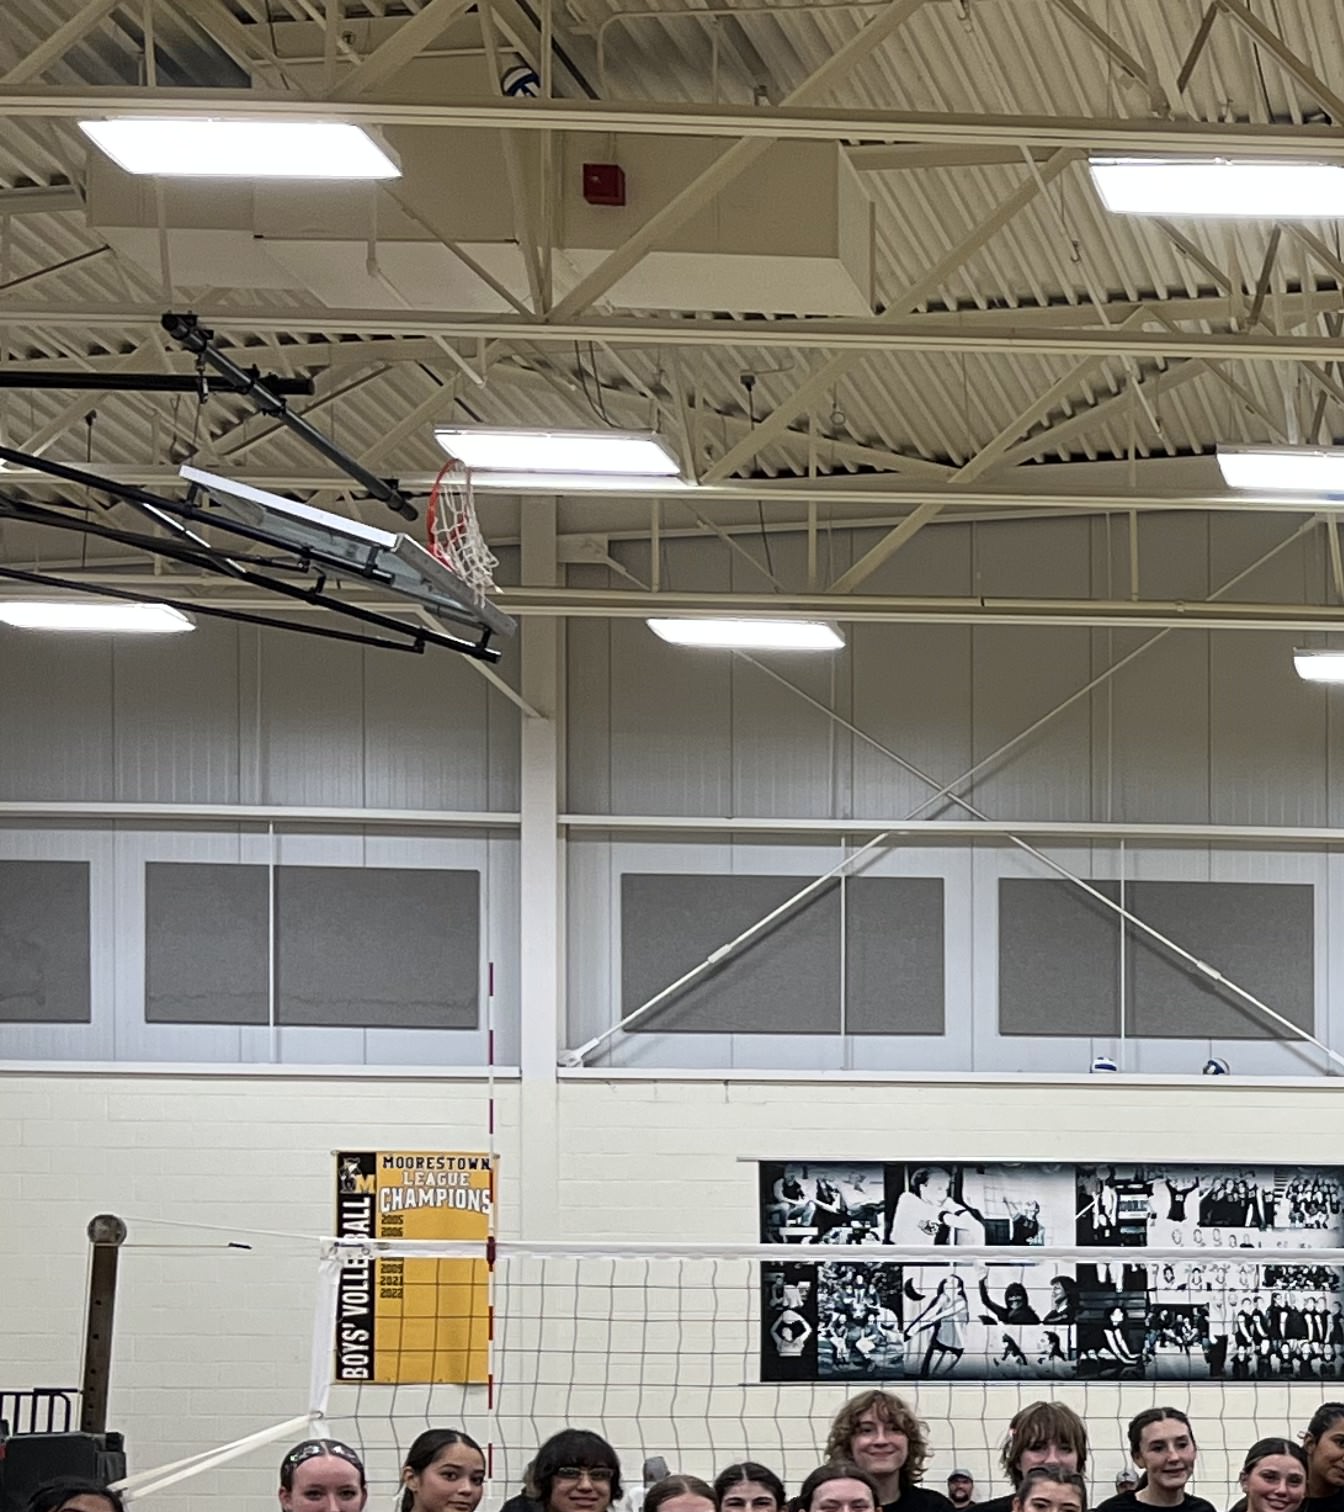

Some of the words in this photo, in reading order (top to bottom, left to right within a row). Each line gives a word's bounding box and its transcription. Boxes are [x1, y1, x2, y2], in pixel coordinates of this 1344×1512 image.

[383, 1156, 491, 1170] MOORESTOWN
[403, 1172, 470, 1187] LEAGUE
[380, 1187, 491, 1214] CHAMPIONS
[341, 1323, 370, 1379] BOYS'
